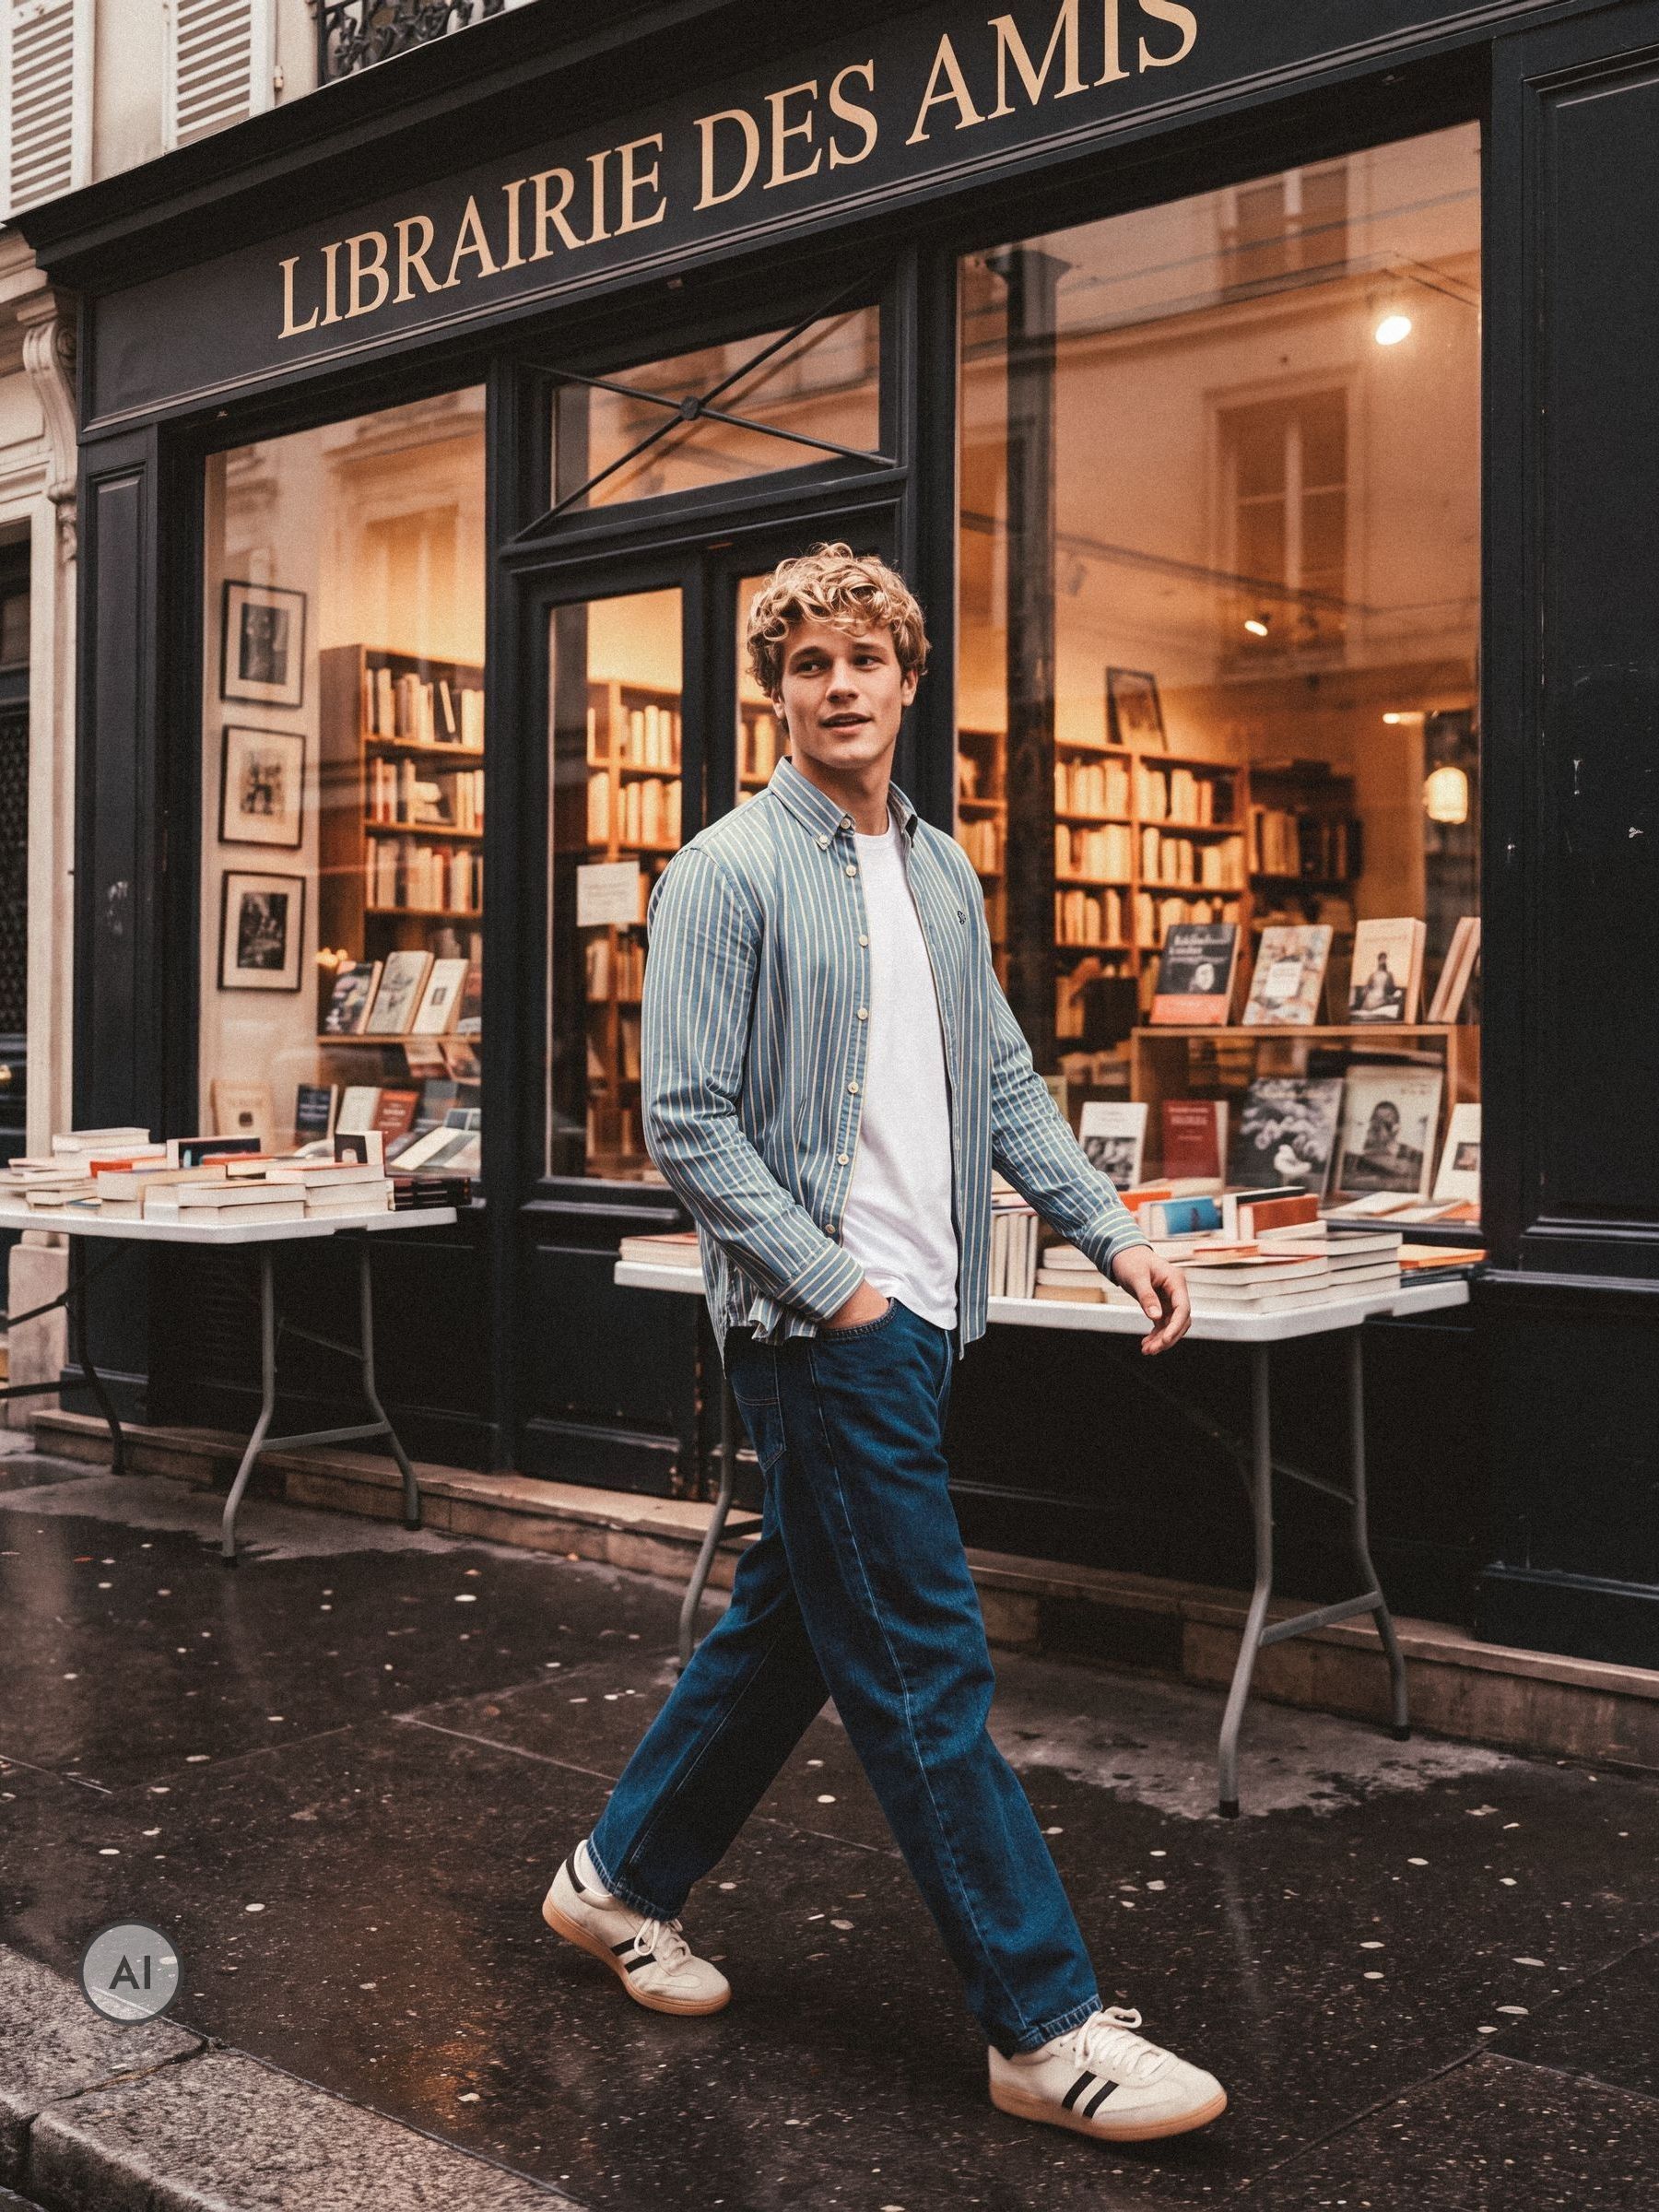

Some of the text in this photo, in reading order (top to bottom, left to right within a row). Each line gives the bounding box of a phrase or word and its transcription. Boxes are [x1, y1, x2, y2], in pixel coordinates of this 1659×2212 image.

[277, 0, 1197, 340] LIBRAIRIE DES AMIS
